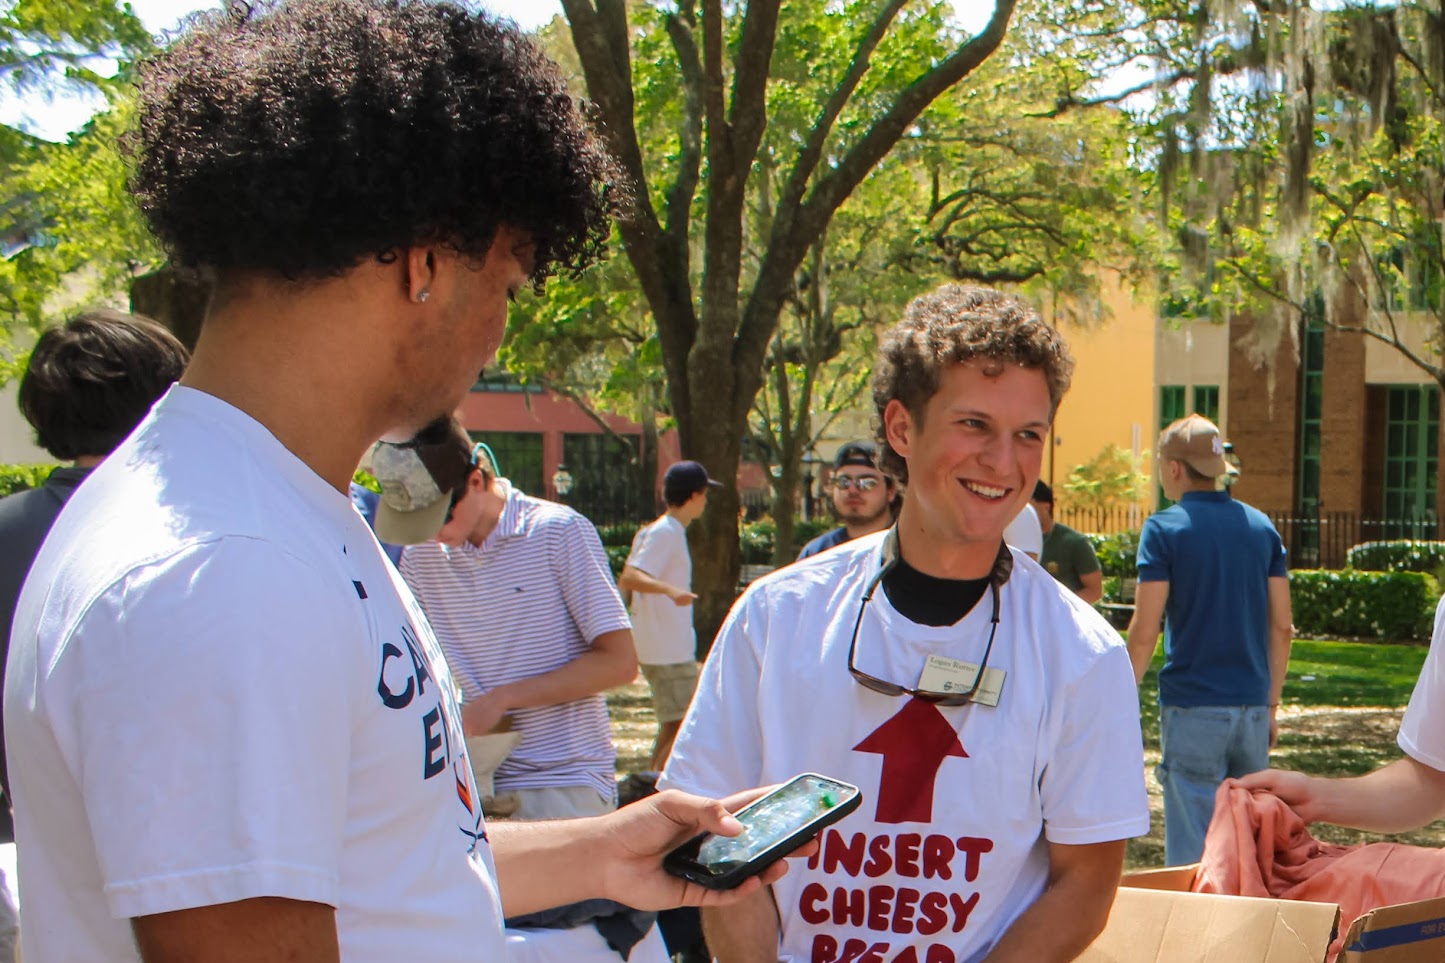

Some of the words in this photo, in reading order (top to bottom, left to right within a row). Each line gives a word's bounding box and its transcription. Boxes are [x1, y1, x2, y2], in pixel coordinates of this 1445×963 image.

[807, 828, 993, 882] INSERT
[799, 882, 980, 935] CHEESY
[1420, 924, 1437, 936] FOR
